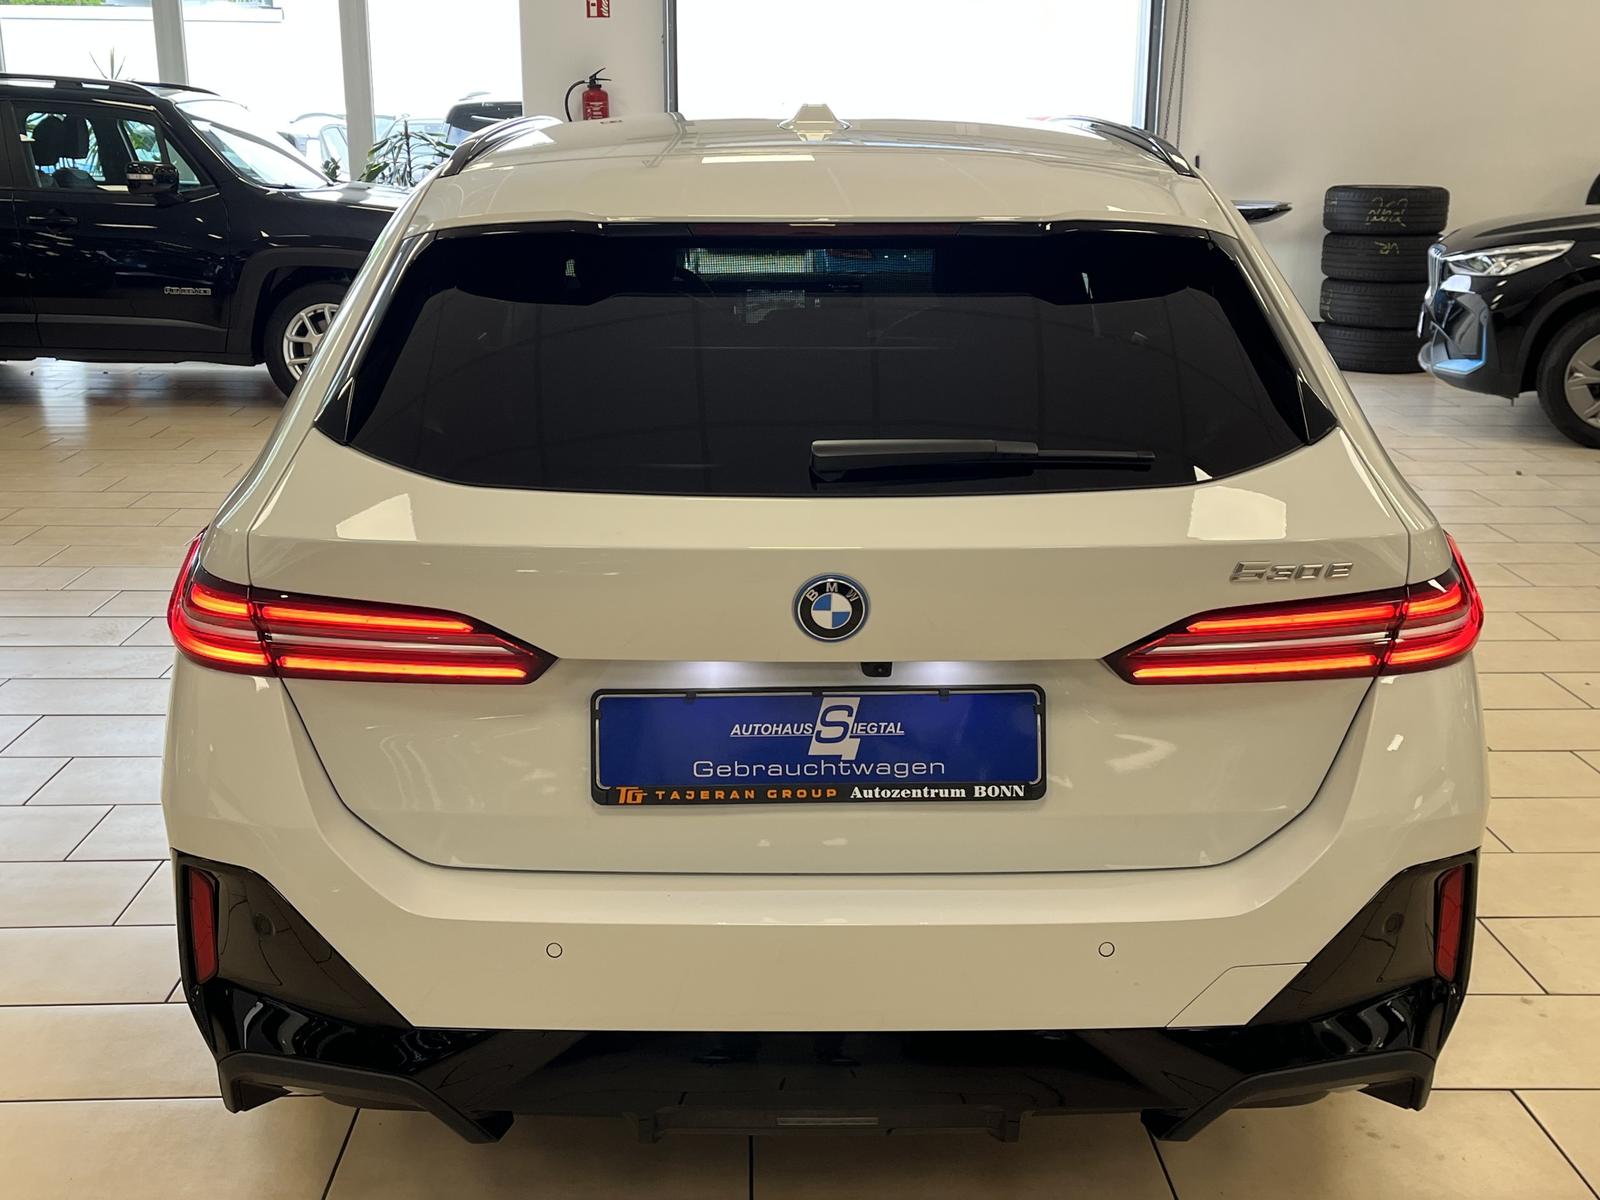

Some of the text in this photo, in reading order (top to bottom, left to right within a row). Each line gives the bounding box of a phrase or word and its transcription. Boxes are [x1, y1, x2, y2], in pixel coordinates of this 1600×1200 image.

[805, 582, 859, 602] BMW
[730, 723, 813, 736] AUTOHAUS
[692, 759, 945, 778] Gebrauchtwagen
[656, 790, 755, 800] TAJERAN
[767, 788, 838, 799] GROUP
[850, 786, 967, 799] Autozentrum
[974, 784, 1025, 798] BONN
